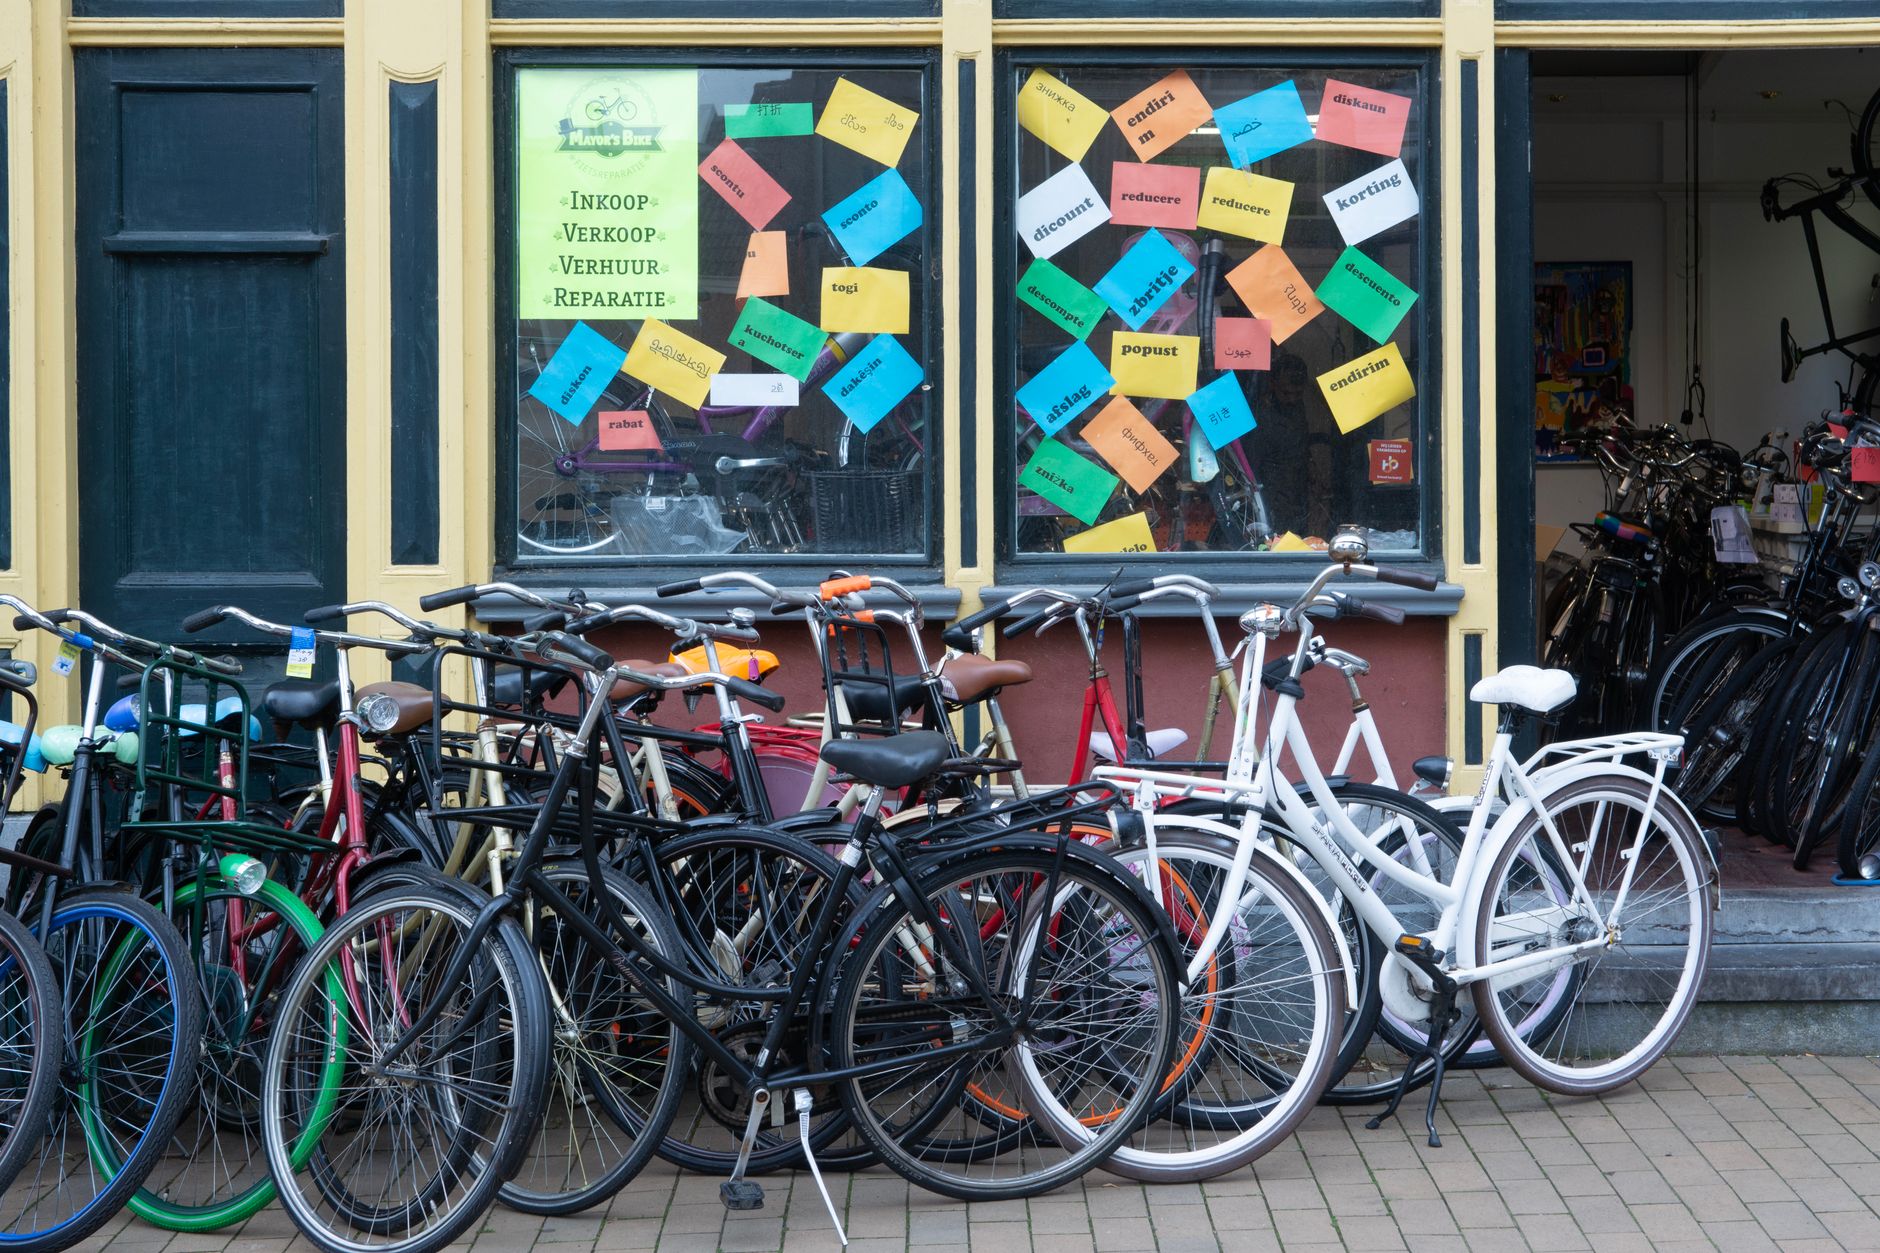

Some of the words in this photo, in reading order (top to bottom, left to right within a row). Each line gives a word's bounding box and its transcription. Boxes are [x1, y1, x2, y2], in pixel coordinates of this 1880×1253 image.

[757, 103, 782, 117] 打折
[1035, 81, 1077, 113] знижка
[1127, 89, 1176, 128] endiri
[1333, 93, 1387, 115] diskaun
[568, 129, 620, 146] MAYOR'S
[622, 129, 652, 146] BIKE
[1138, 129, 1156, 145] m
[1231, 118, 1263, 142] خصم
[709, 164, 746, 200] scontu
[1336, 171, 1402, 212] korting
[570, 190, 649, 211] INKOOP
[840, 198, 879, 230] sconto
[1121, 192, 1181, 205] reducere
[1212, 196, 1271, 217] reducere
[562, 222, 656, 243] VERKOOP
[1033, 196, 1095, 243] dicount
[558, 255, 660, 276] VERHUUR
[553, 287, 666, 308] REPARATIE
[831, 282, 859, 296] togi
[1129, 265, 1180, 318] zbritje
[1284, 283, 1308, 315] զեղչ
[1344, 261, 1402, 307] descuento
[1027, 283, 1086, 329] descompte
[737, 339, 746, 349] a
[743, 324, 806, 362] kuchotser
[1121, 343, 1179, 358] popust
[560, 364, 593, 406] diskon
[840, 355, 883, 398] dakêşin
[1329, 357, 1391, 393] endirim
[1046, 384, 1092, 425] afslag
[608, 418, 644, 430] rabat
[1121, 426, 1160, 467] тахфиф
[1035, 465, 1075, 495] zniżka
